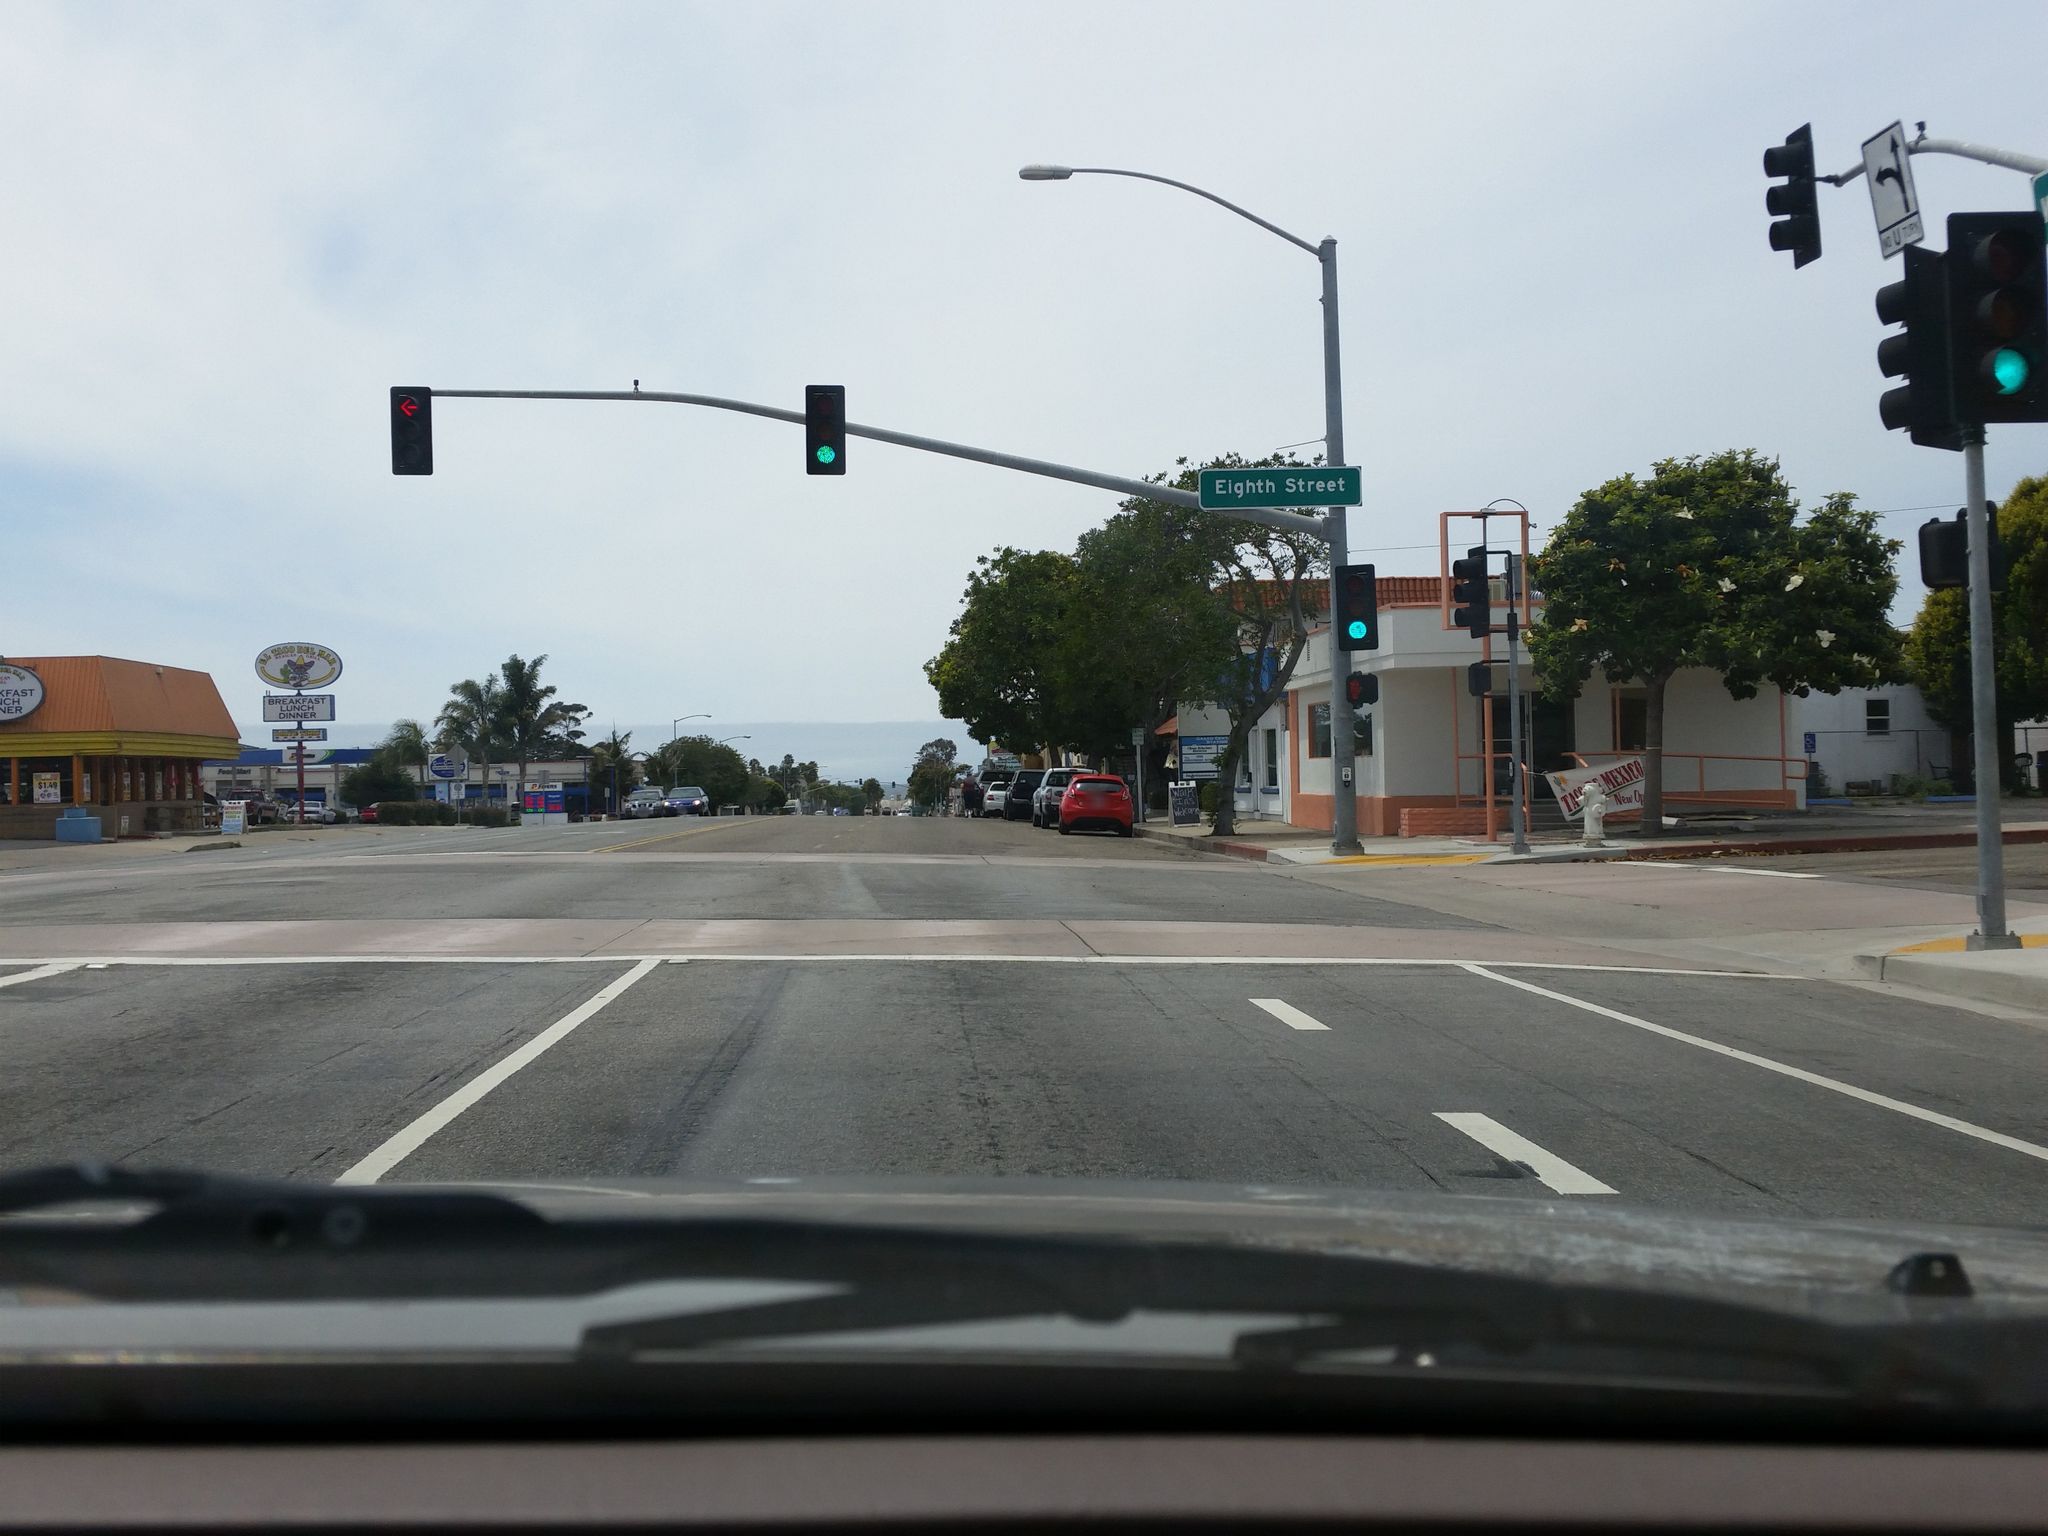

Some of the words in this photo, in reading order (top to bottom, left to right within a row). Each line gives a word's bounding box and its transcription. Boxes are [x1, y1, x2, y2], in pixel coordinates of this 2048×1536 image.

[1892, 228, 1902, 246] U
[1215, 479, 1276, 499] Eighth
[1285, 477, 1346, 493] Street
[268, 698, 326, 706] BREAKFAST
[280, 704, 315, 712] LUNCH
[1600, 760, 1644, 791] MEXICO
